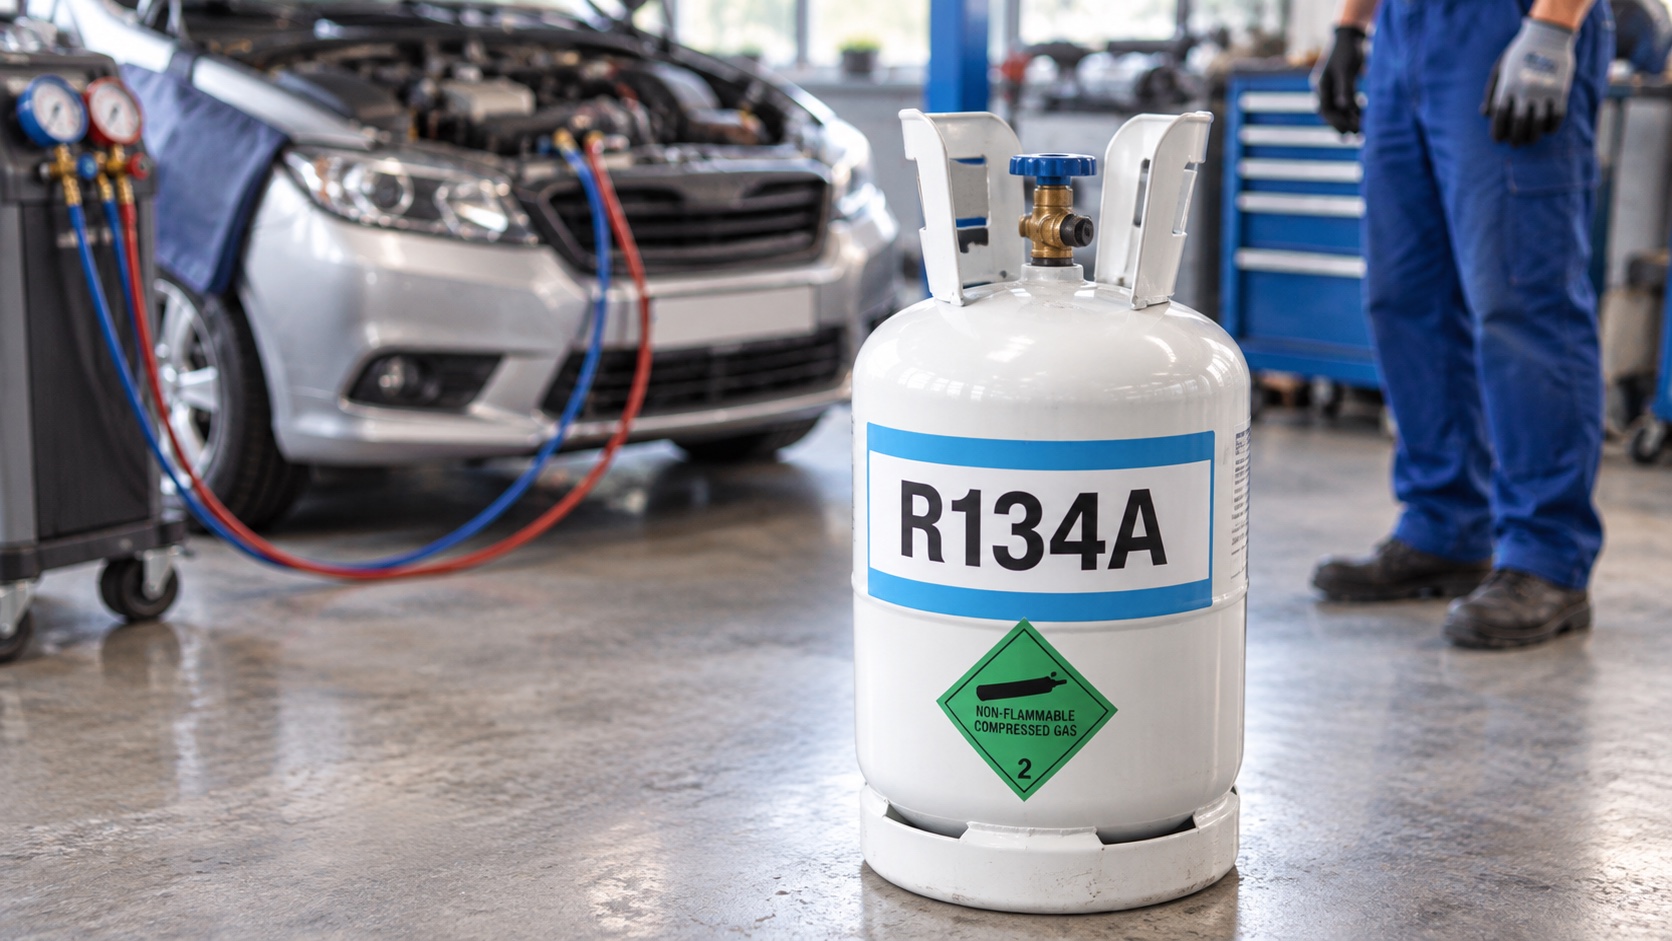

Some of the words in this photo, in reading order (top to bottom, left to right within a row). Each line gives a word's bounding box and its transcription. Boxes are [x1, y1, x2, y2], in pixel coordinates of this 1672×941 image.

[901, 480, 1168, 571] R134A
[976, 705, 1076, 721] NON-FLAMMABLE
[974, 720, 1051, 736] COMPRESSED
[1053, 724, 1077, 737] GAS
[1017, 758, 1032, 780] 2
